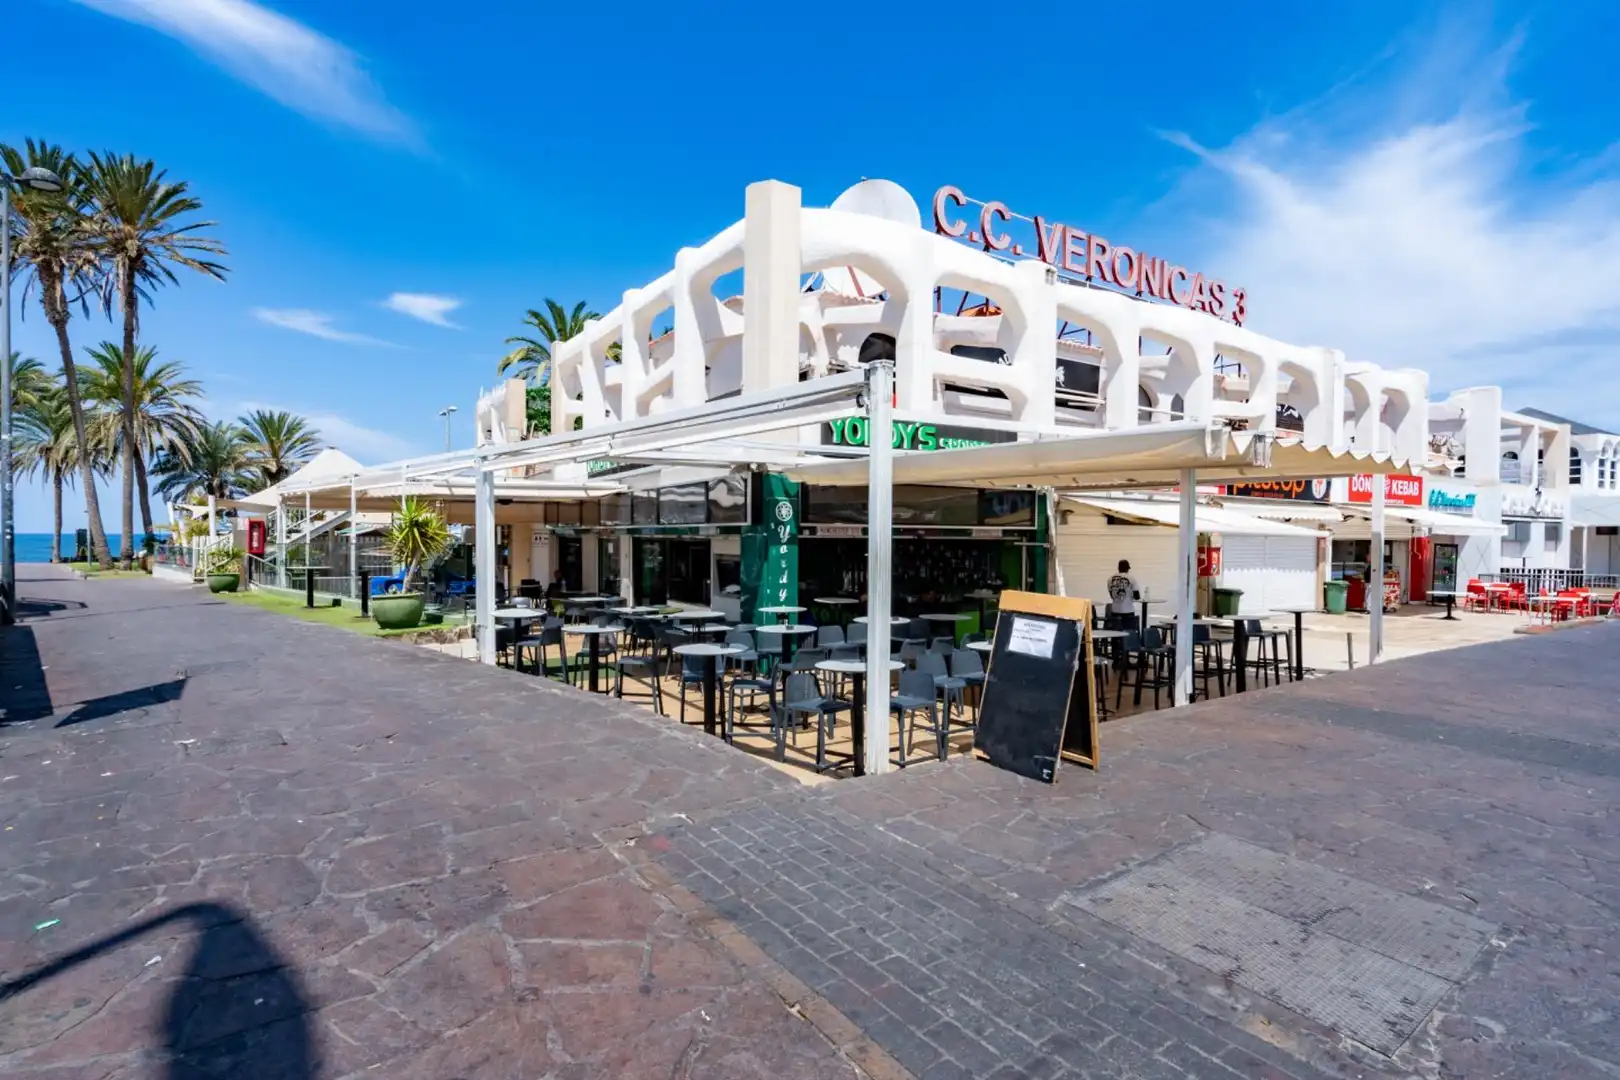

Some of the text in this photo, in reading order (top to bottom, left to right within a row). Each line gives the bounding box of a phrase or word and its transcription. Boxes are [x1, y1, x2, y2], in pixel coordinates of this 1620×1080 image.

[933, 185, 1248, 323] C.C. VERONICAS 3
[1391, 479, 1420, 496] KEBAB
